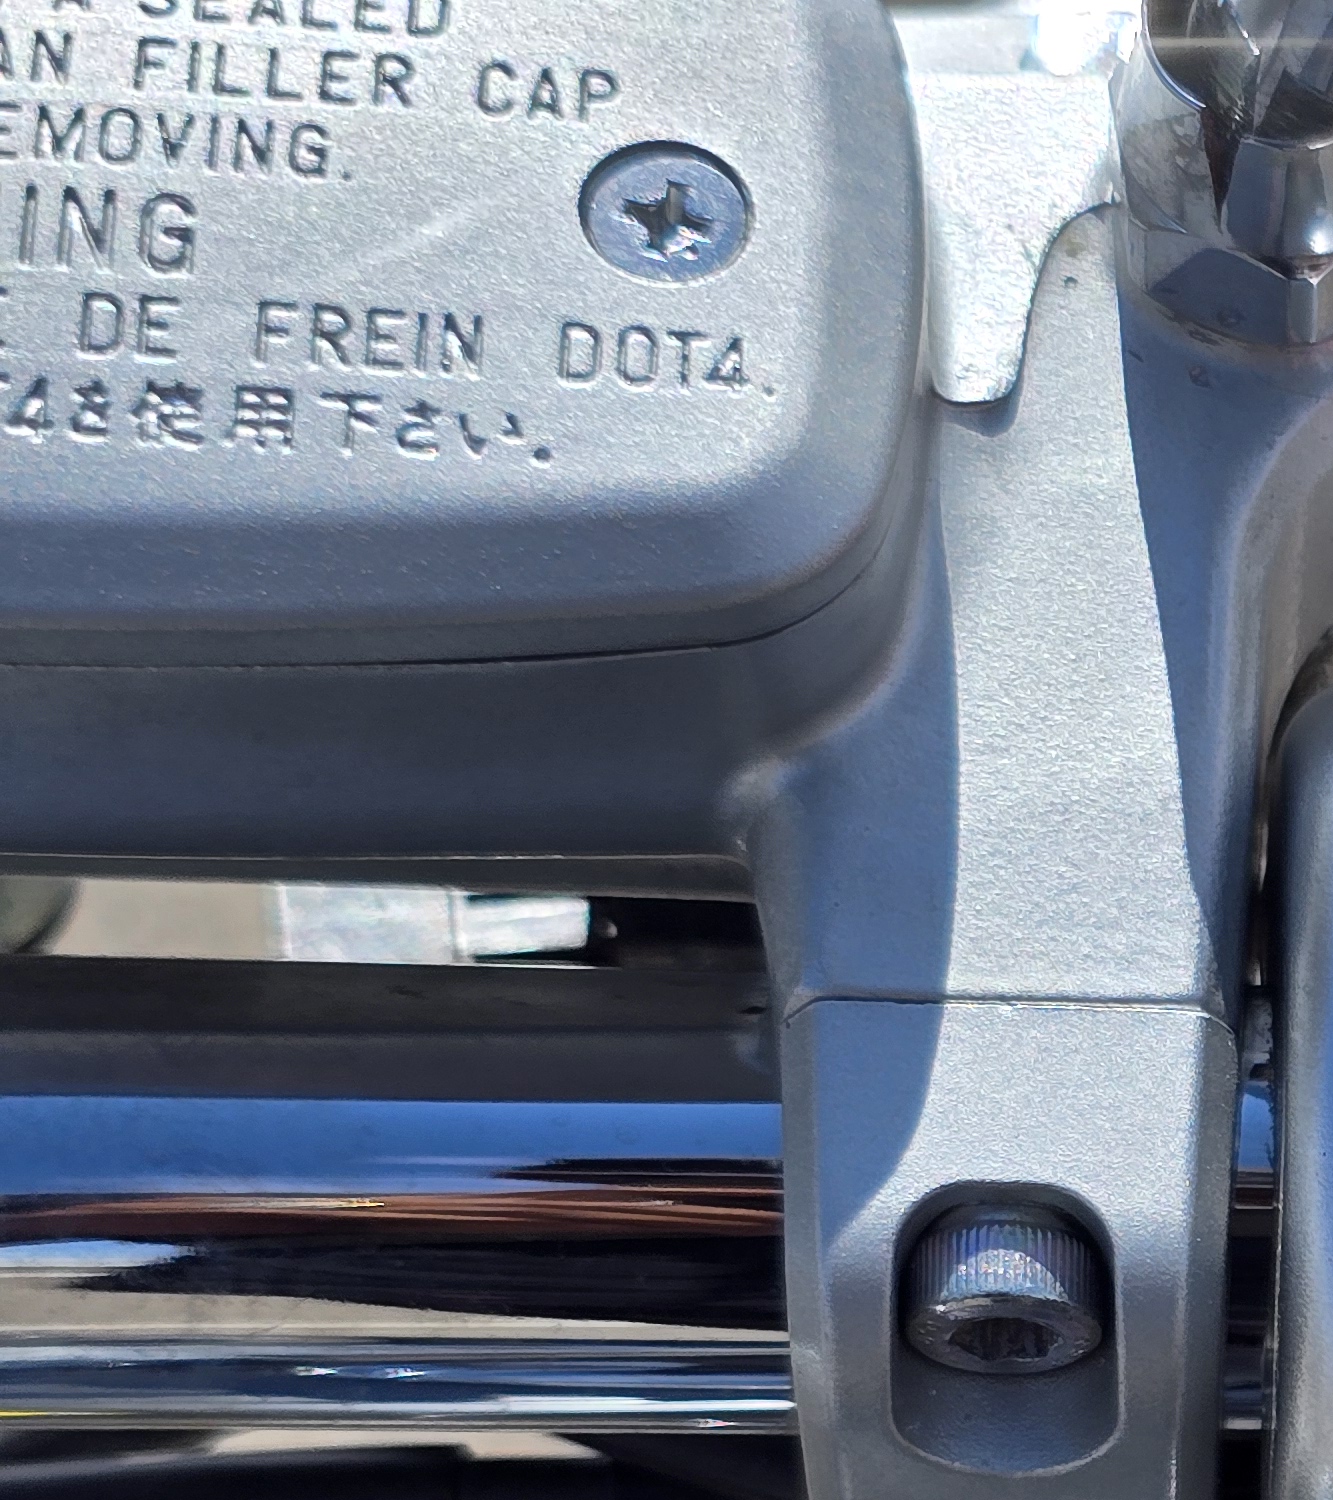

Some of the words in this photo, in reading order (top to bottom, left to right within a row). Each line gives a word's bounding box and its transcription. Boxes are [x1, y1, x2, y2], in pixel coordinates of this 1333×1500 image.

[133, 36, 415, 108] FILLER
[475, 58, 620, 122] CAP
[79, 291, 181, 358] DE
[254, 300, 485, 378] FREIN
[557, 320, 777, 398] DOT4.
